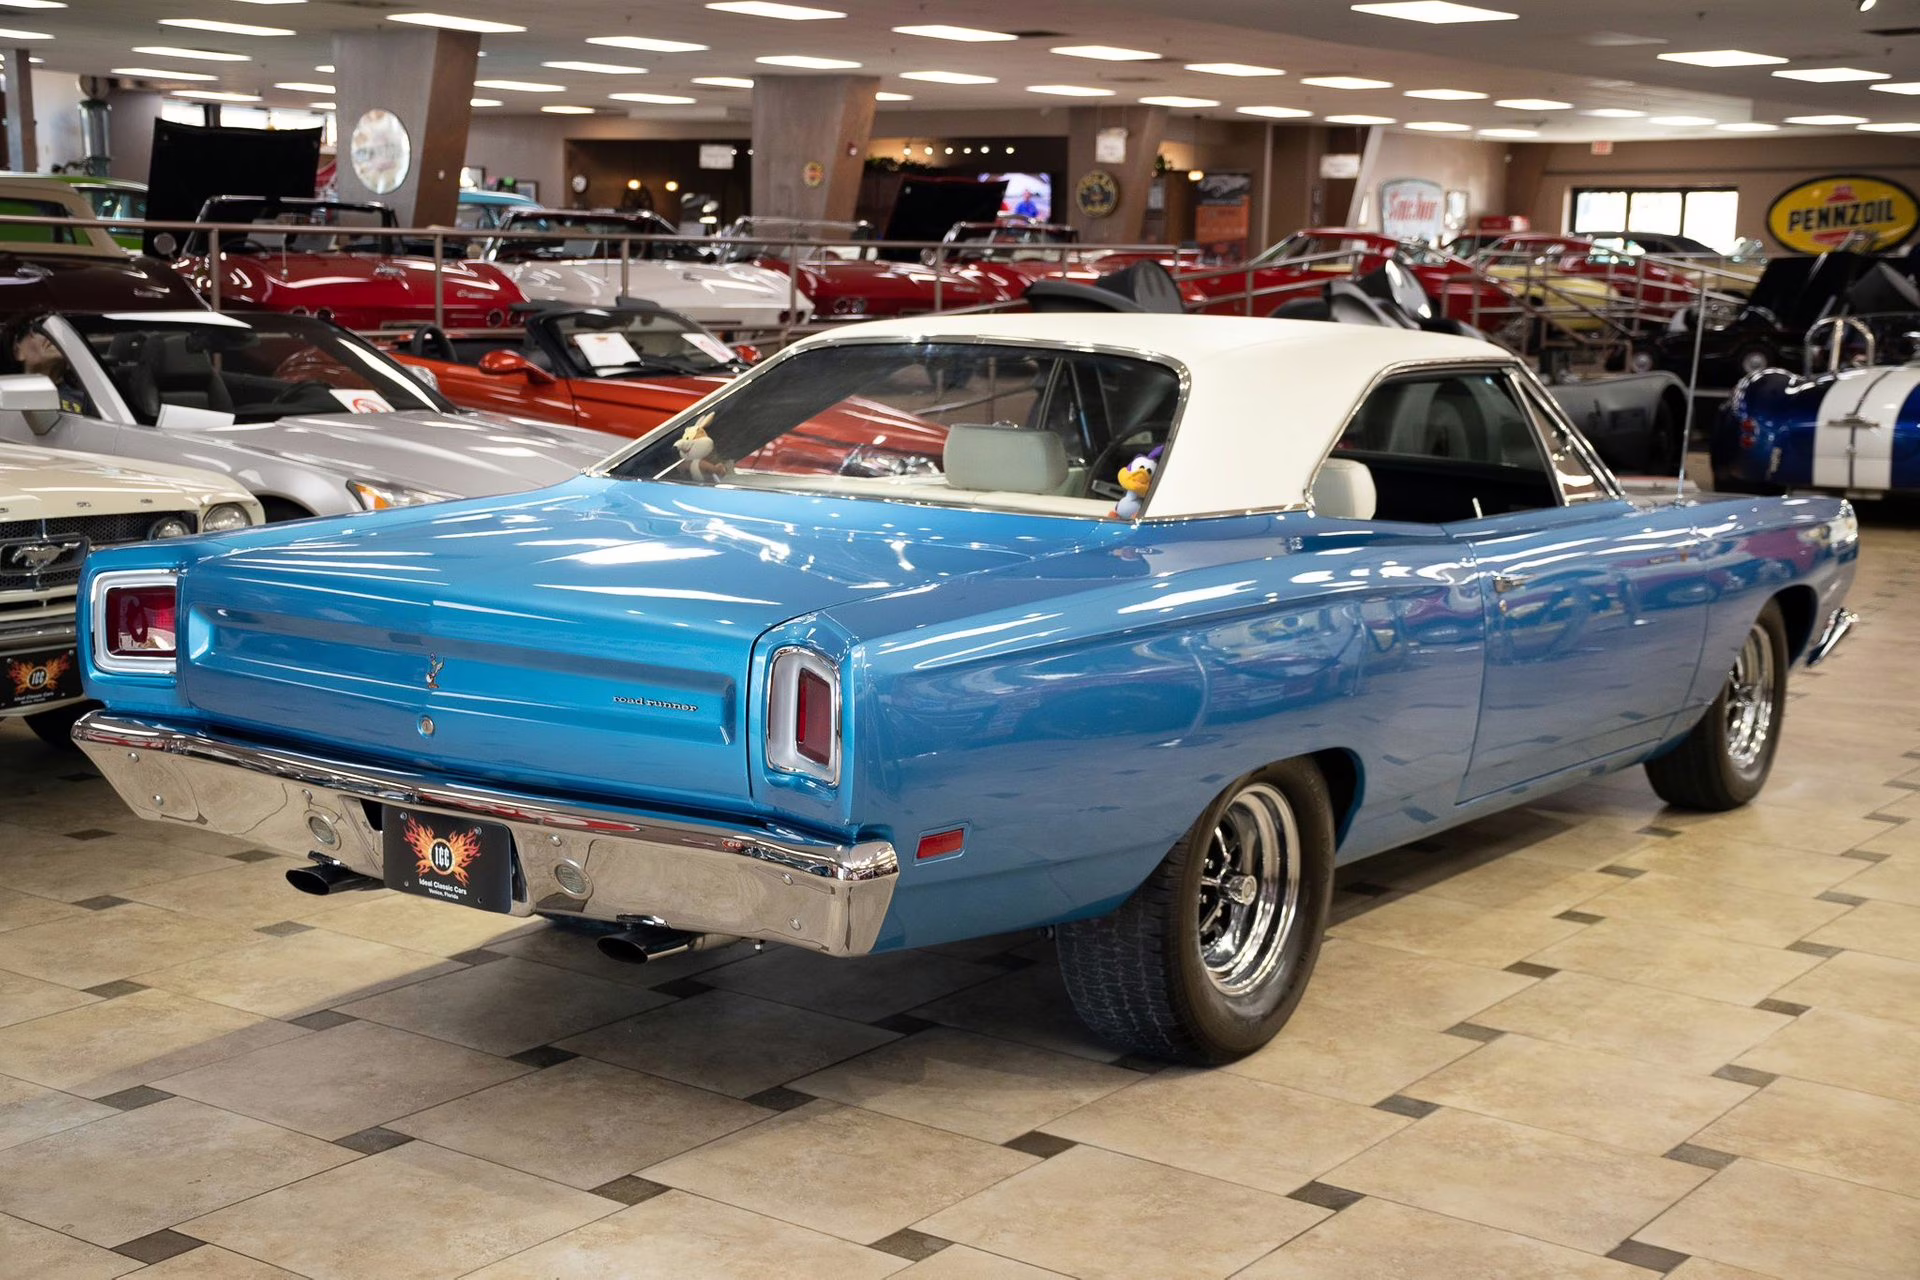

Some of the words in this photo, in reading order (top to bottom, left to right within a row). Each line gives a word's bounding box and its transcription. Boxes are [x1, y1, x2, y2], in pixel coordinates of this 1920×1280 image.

[1788, 199, 1895, 232] PENNZOIL
[613, 696, 645, 705] road
[645, 700, 699, 712] runner
[434, 845, 450, 869] ICC
[419, 878, 433, 887] Ideal
[433, 881, 454, 892] Classic
[454, 885, 467, 895] Cars
